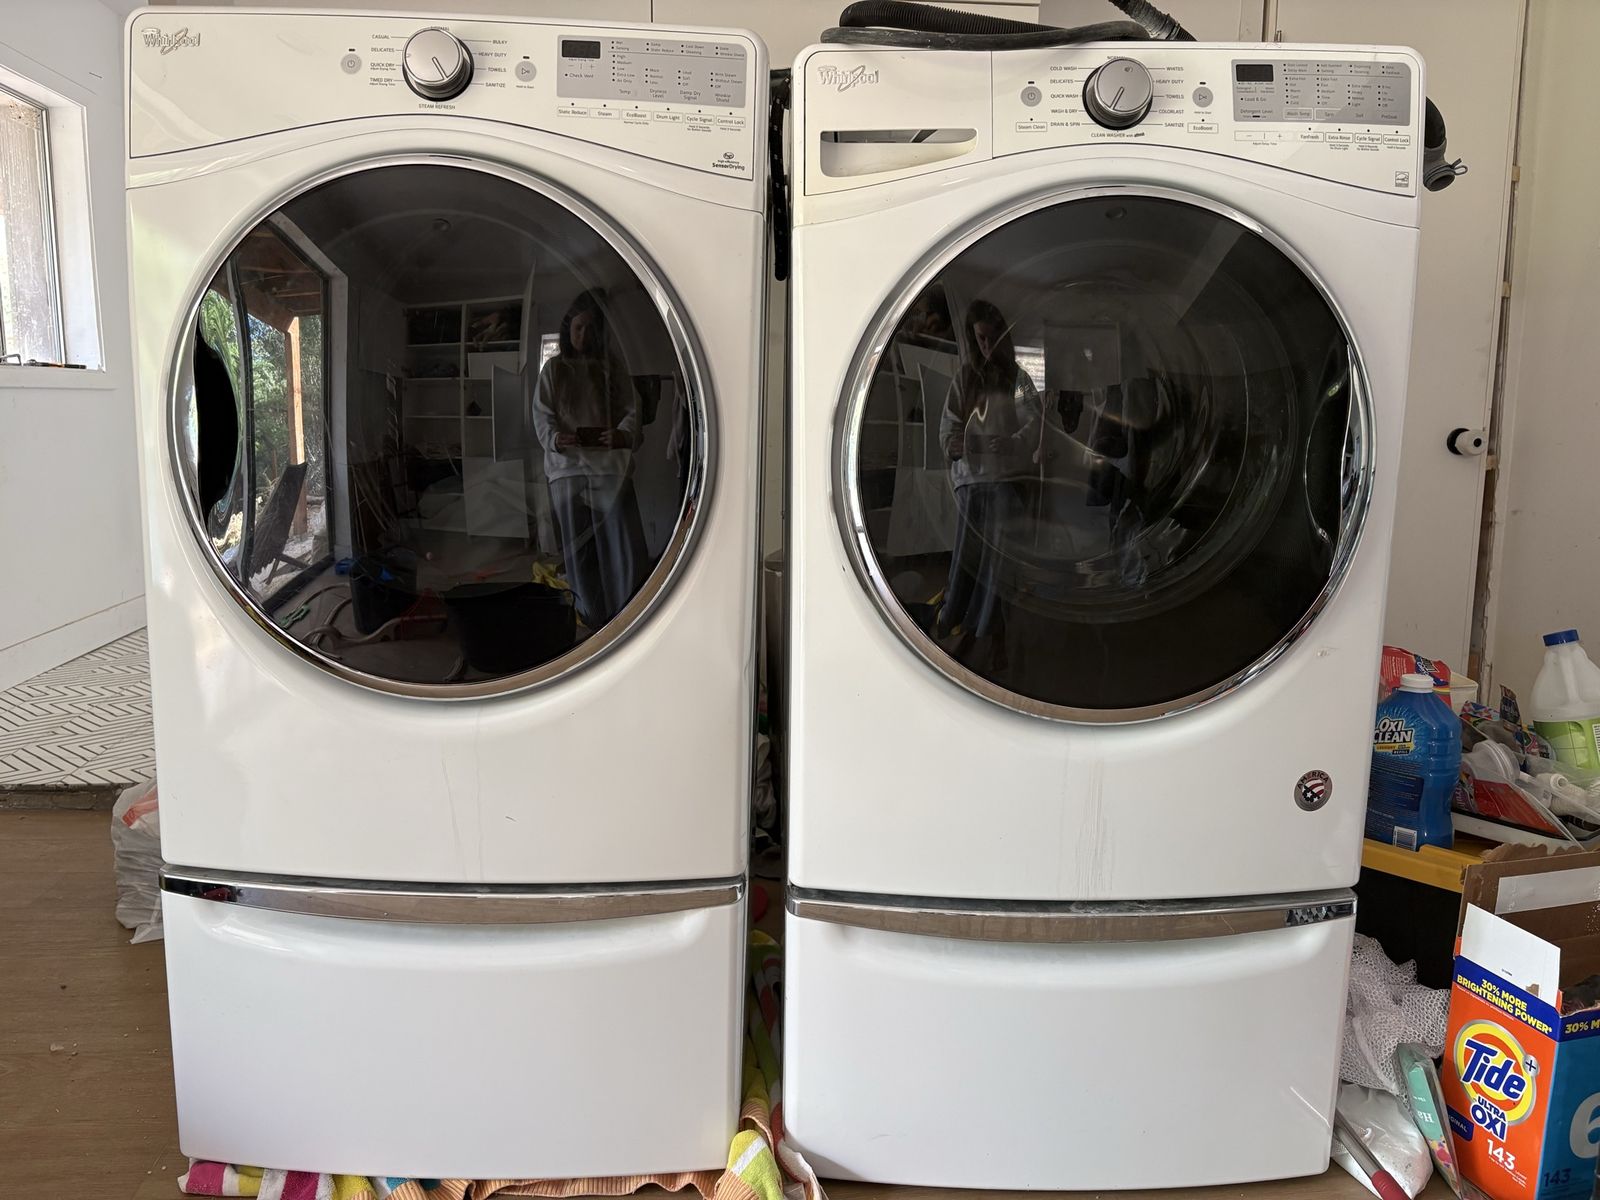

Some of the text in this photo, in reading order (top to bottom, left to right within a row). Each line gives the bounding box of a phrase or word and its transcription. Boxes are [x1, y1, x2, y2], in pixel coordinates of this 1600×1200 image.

[818, 65, 879, 93] Whirlpool
[712, 163, 746, 171] SensorDrying
[1379, 718, 1403, 733] OXI
[1457, 975, 1514, 1014] BRIGHTENING
[1481, 979, 1500, 996] 30%
[1501, 990, 1528, 1012] MORE
[1565, 1022, 1589, 1034] 30%
[1461, 1038, 1527, 1101] Tide
[1471, 1104, 1507, 1141] OXI
[1477, 1096, 1506, 1122] ULTRA
[1487, 1138, 1516, 1171] 143
[1544, 1168, 1571, 1189] 143
